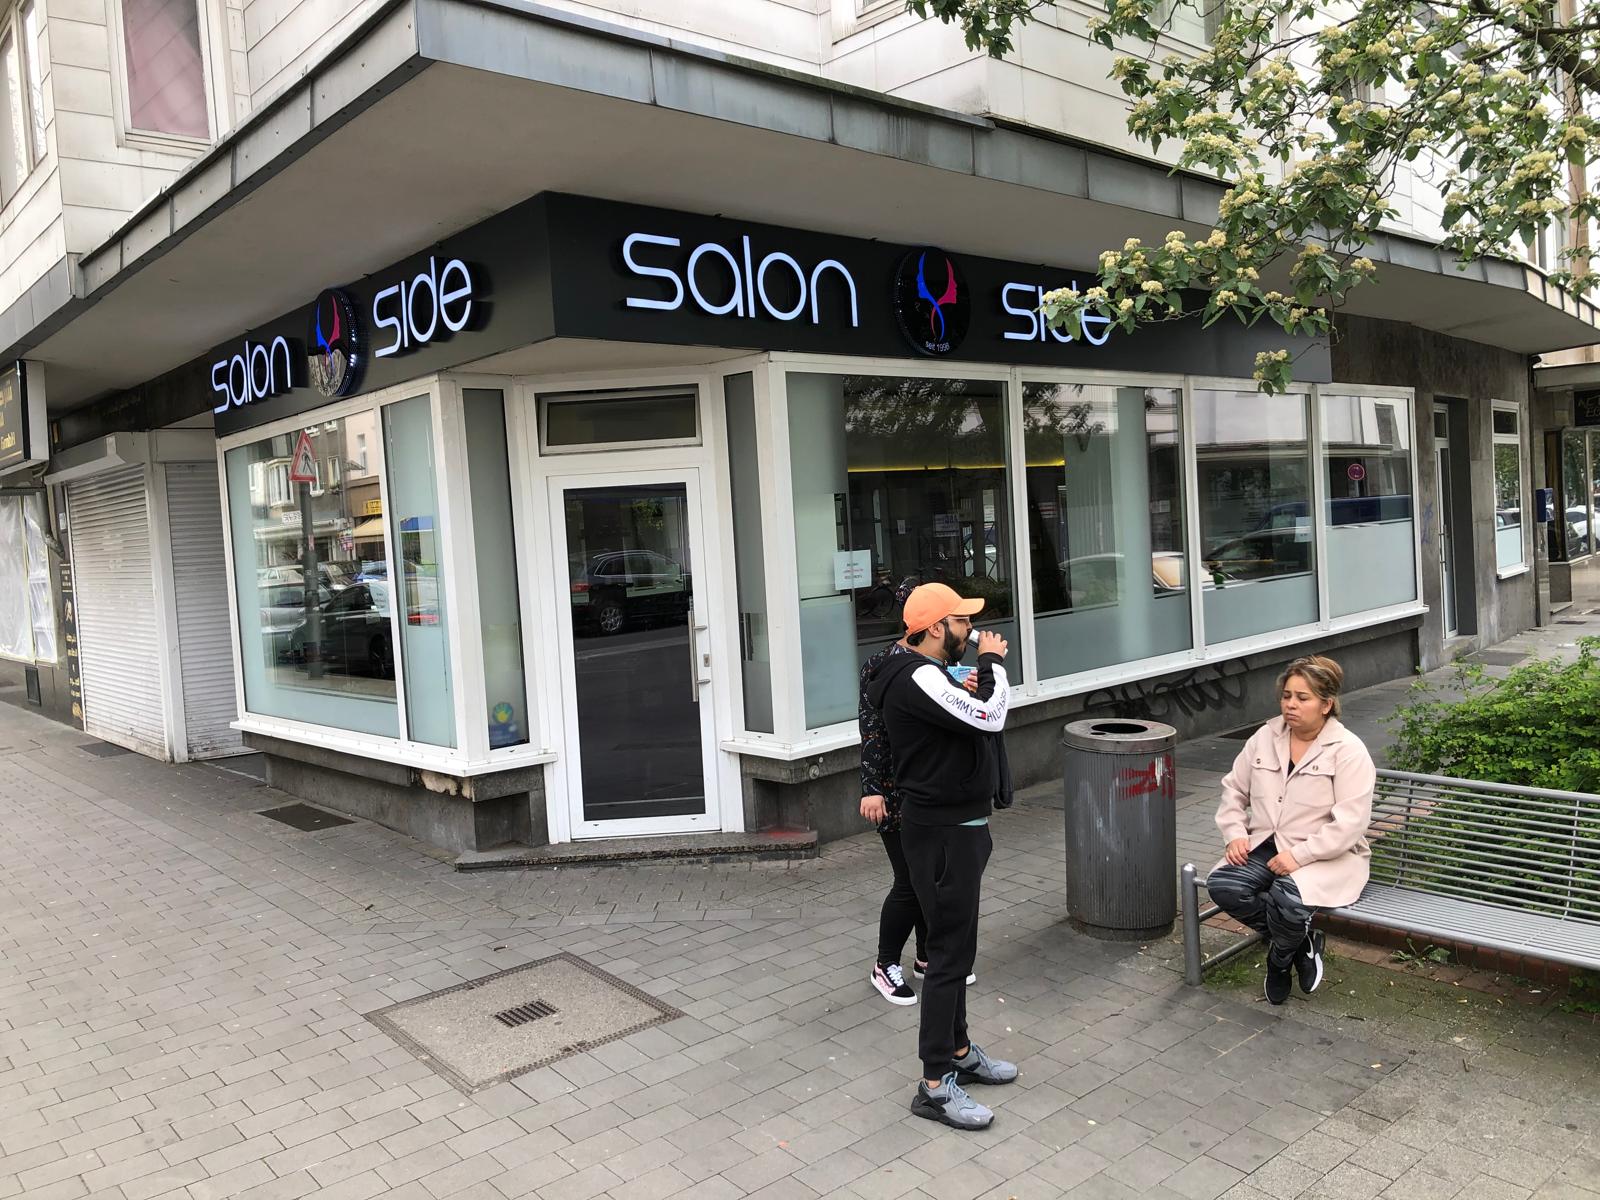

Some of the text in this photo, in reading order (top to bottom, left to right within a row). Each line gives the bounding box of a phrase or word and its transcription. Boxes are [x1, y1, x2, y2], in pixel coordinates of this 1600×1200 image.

[622, 232, 858, 327] salon
[211, 256, 472, 414] salon side
[941, 689, 976, 716] TOMMY
